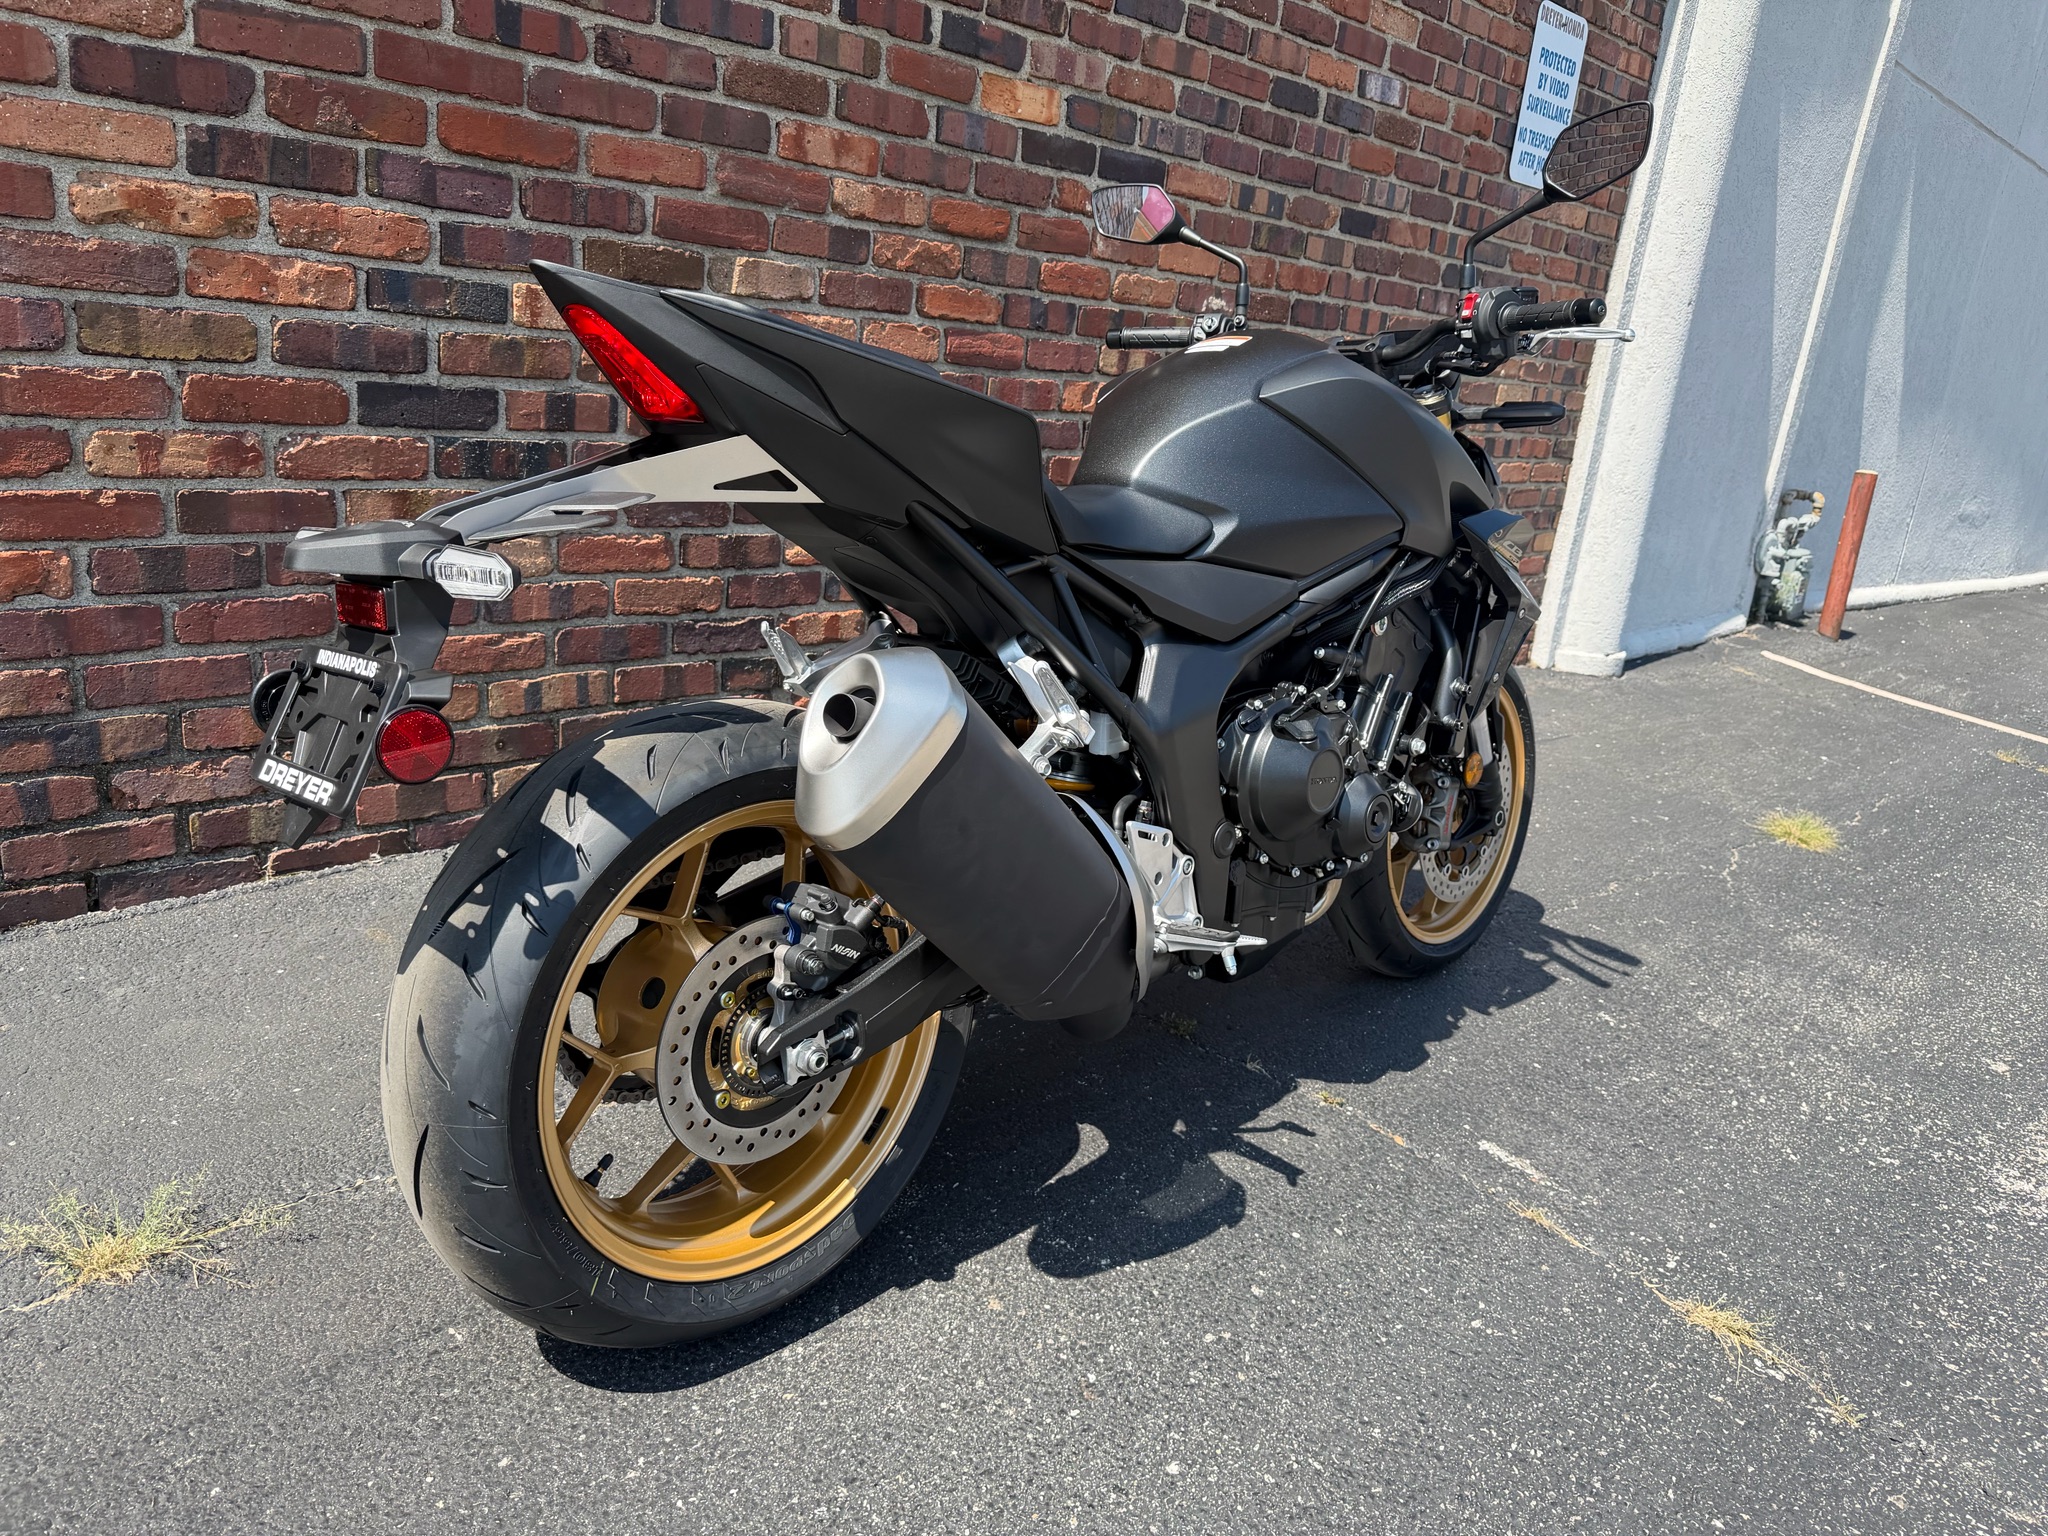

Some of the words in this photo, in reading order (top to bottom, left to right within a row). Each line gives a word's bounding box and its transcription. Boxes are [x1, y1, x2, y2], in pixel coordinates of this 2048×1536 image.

[1539, 46, 1577, 77] PROTECTED
[1537, 72, 1549, 91] BY
[1549, 75, 1570, 100] VIDEO
[1526, 93, 1571, 125] SURVEILLANCE
[1518, 126, 1527, 143] NO
[1518, 150, 1536, 170] AFTER
[316, 649, 378, 677] INDIANAPOLIS
[258, 758, 335, 806] DREYER
